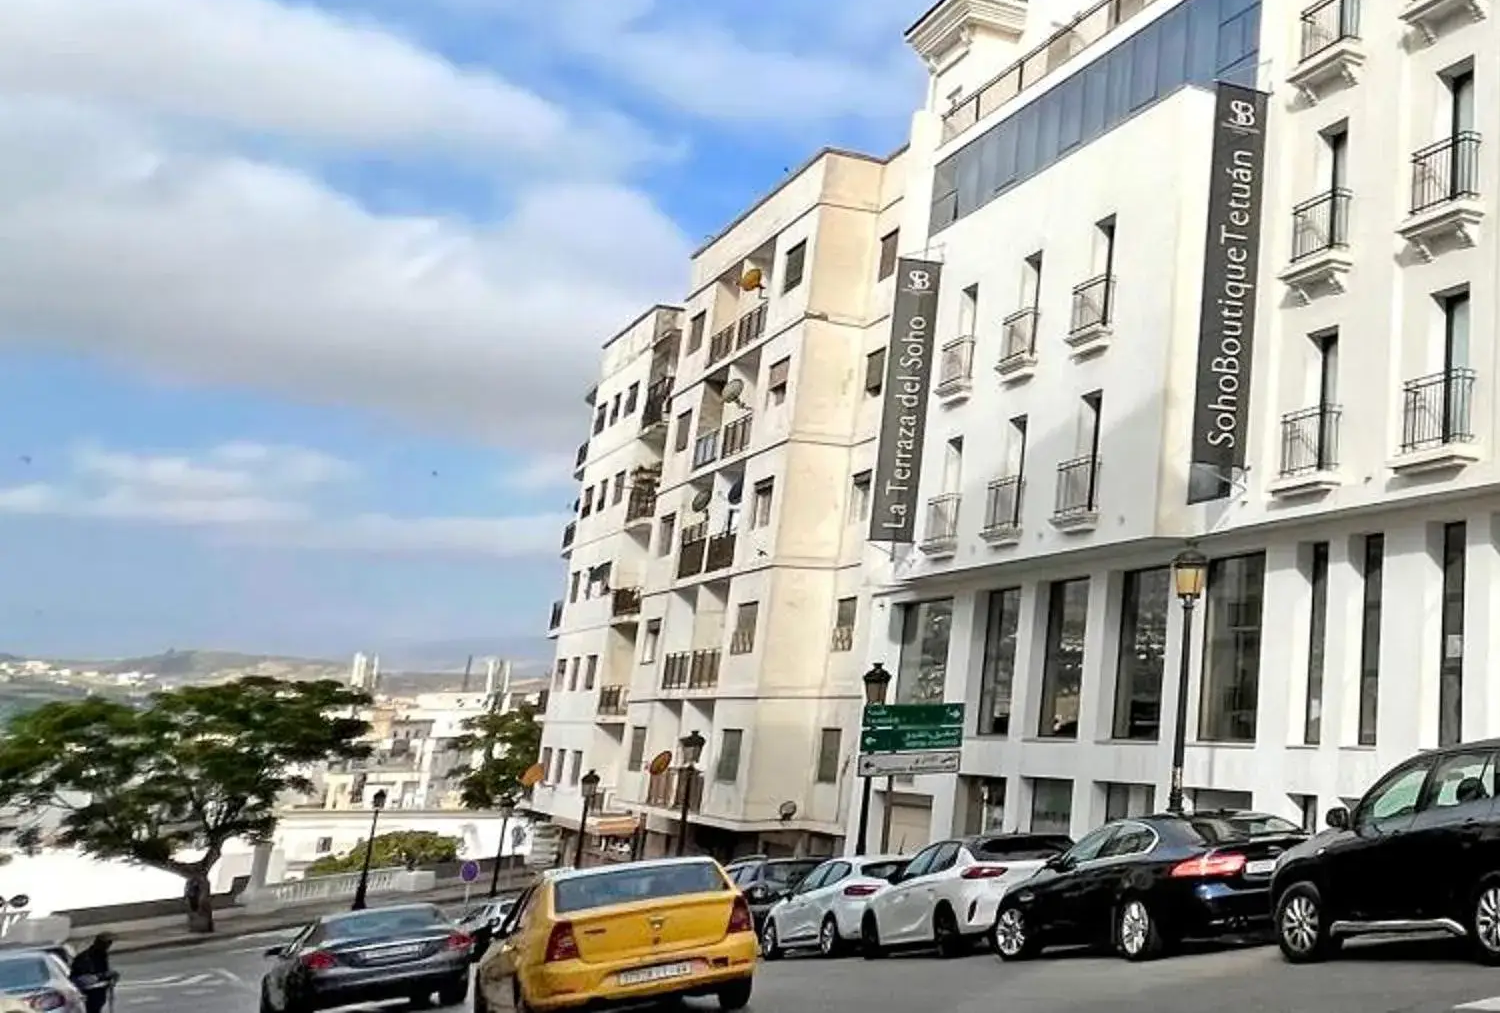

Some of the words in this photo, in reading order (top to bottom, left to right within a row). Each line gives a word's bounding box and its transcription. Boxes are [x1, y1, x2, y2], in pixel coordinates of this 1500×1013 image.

[1207, 149, 1254, 448] SohoBoutiqueTetuán
[899, 316, 928, 369] Soho
[894, 375, 921, 408] del
[886, 414, 917, 496] Terraza
[881, 504, 908, 529] La
